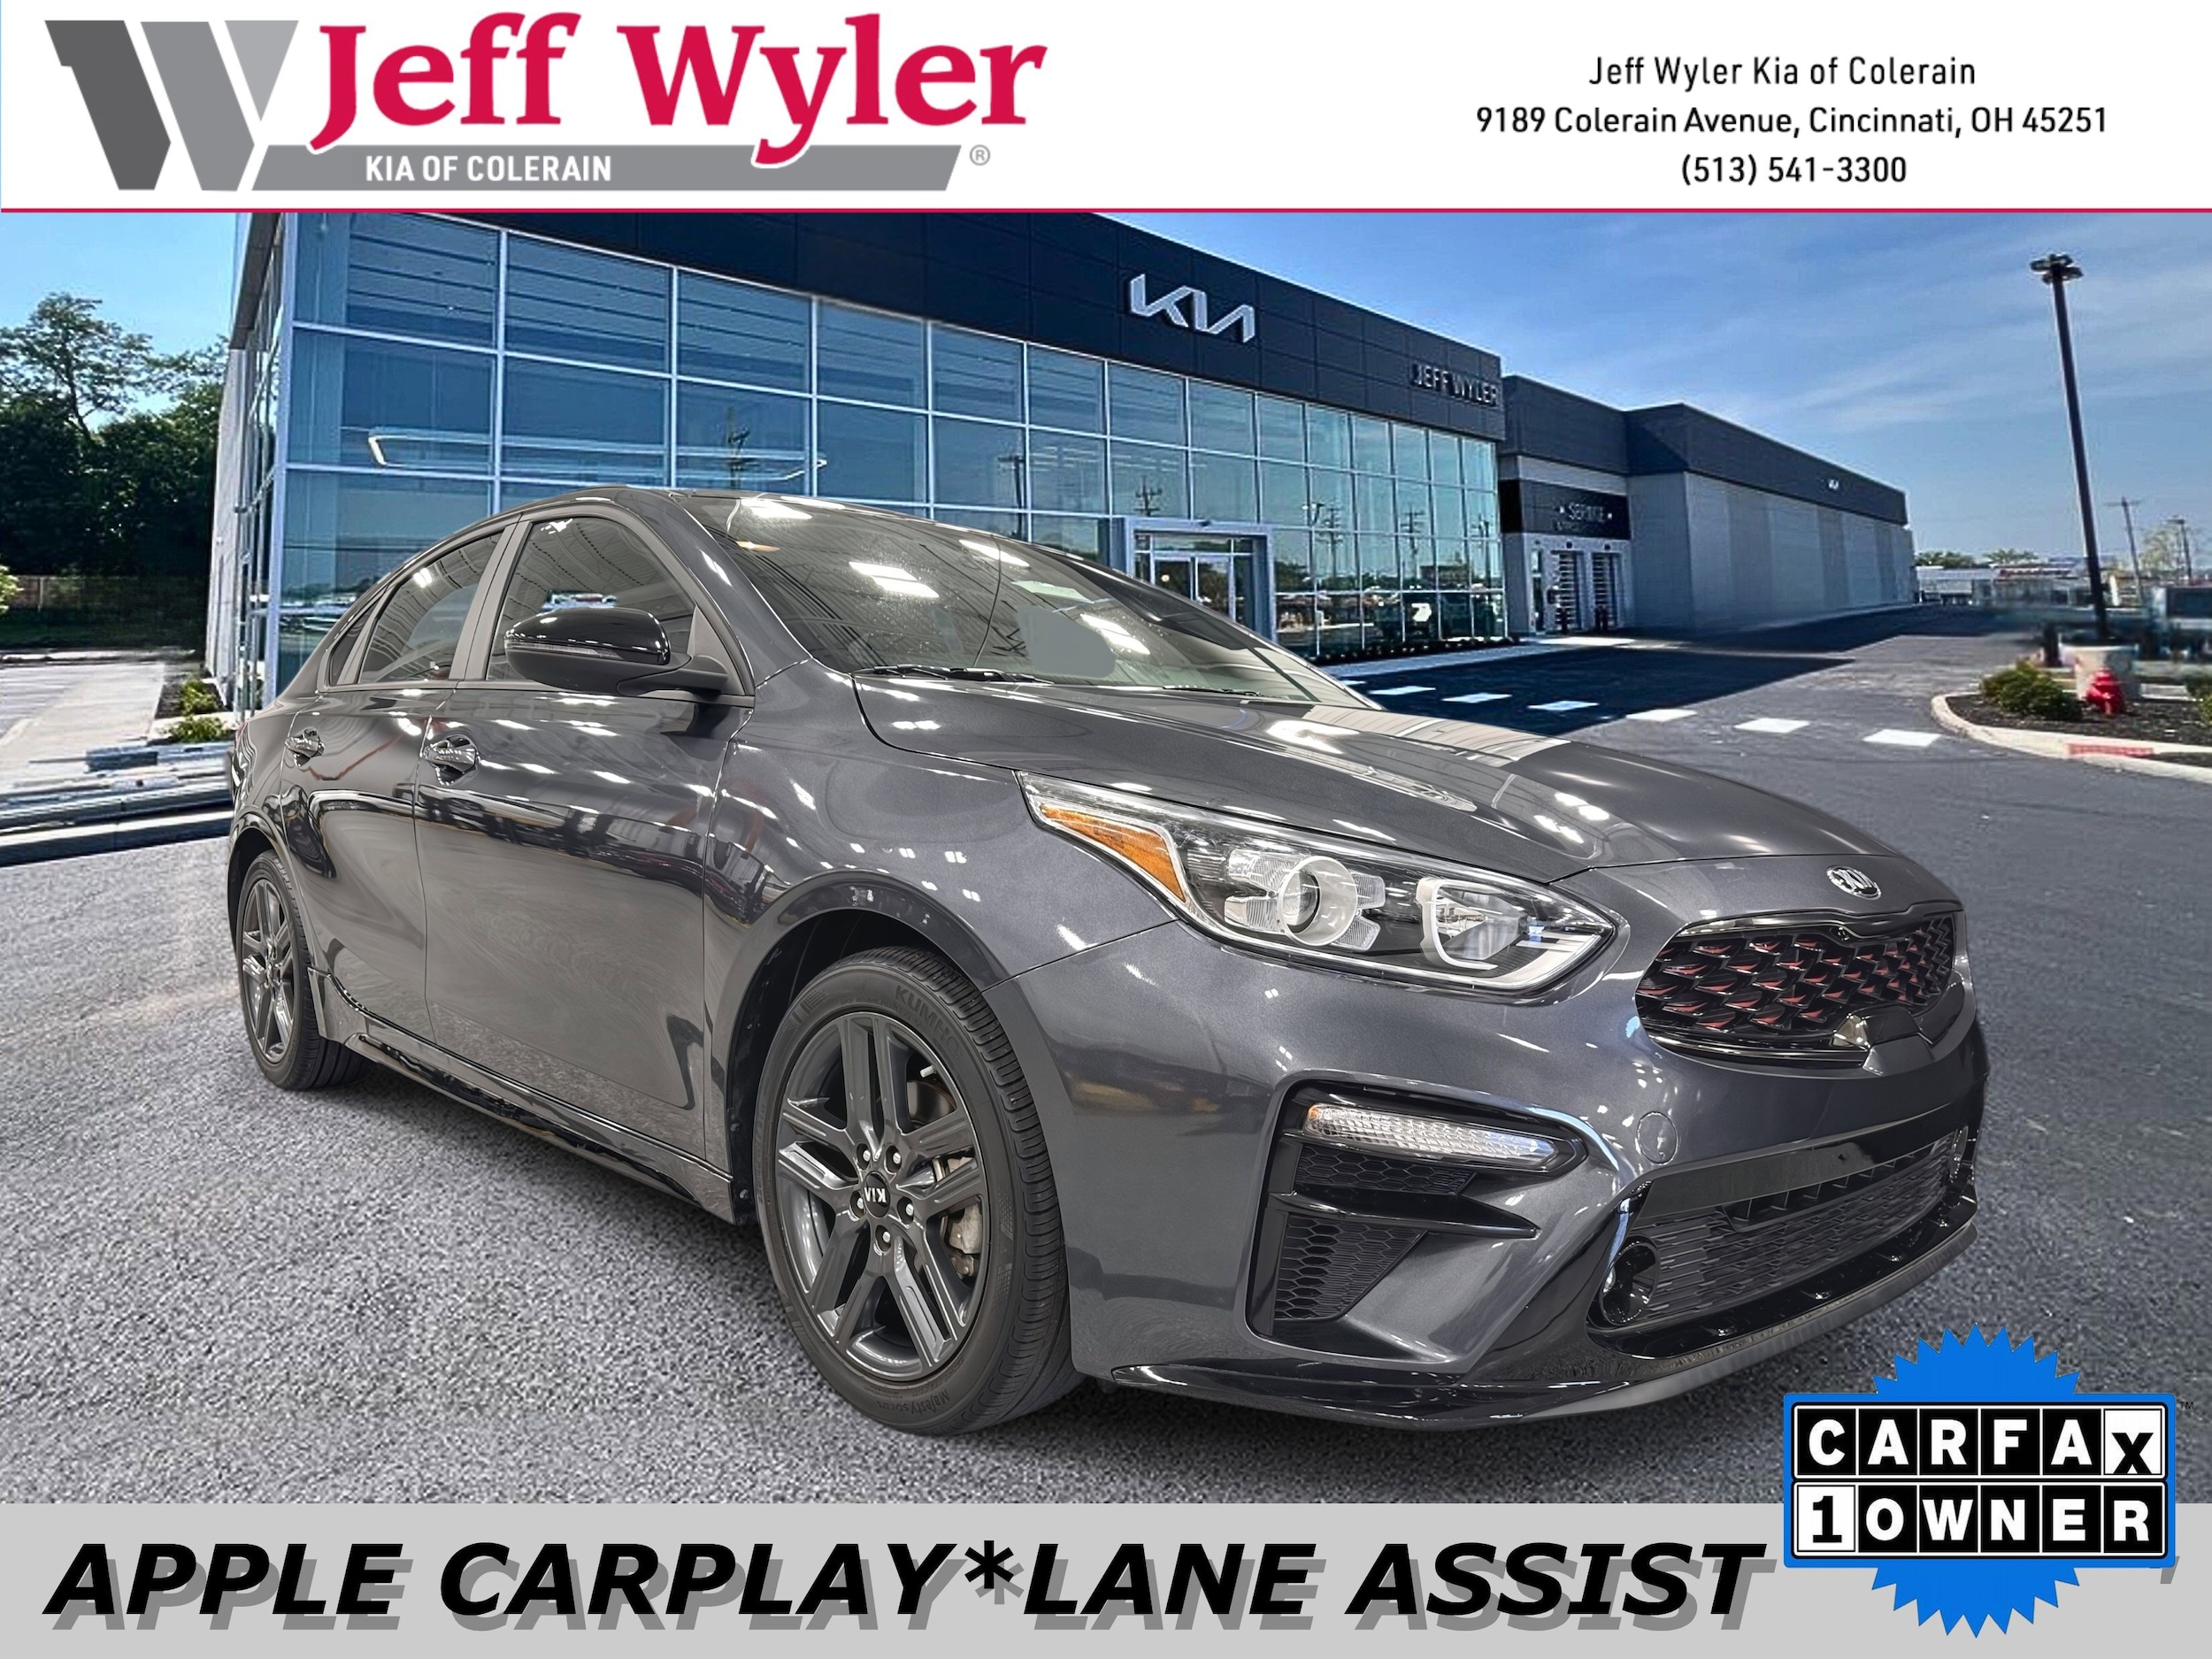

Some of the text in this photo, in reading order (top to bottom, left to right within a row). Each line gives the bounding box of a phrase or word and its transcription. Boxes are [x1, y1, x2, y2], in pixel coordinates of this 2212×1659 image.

[1130, 273, 1256, 343] KIA
[1412, 363, 1500, 408] JEFF WYLER
[895, 984, 960, 1053] KUMHO
[864, 1187, 887, 1202] KIA
